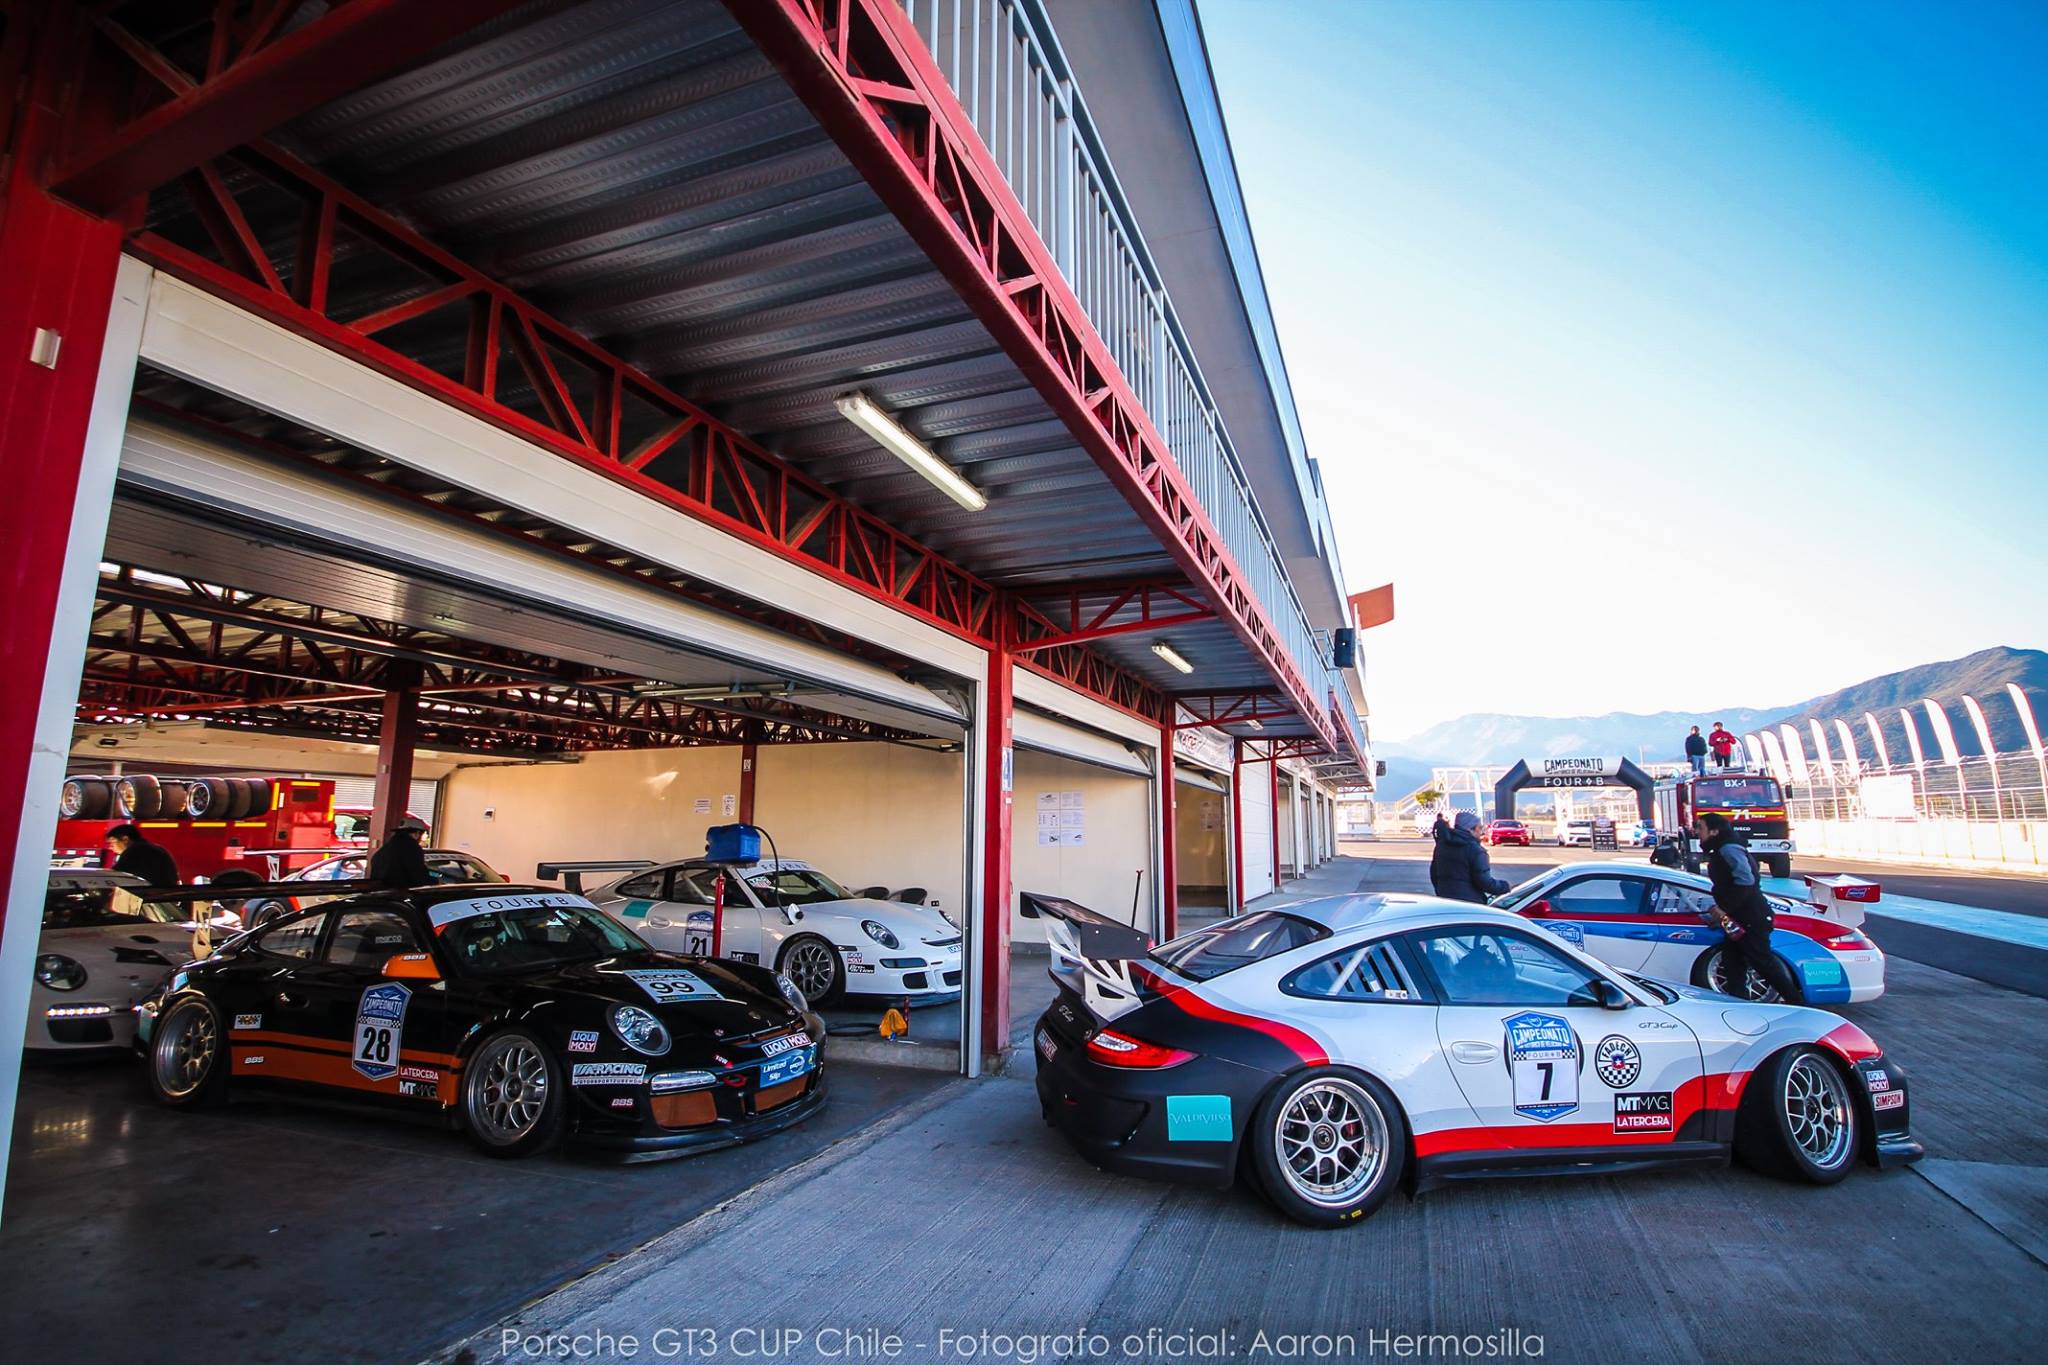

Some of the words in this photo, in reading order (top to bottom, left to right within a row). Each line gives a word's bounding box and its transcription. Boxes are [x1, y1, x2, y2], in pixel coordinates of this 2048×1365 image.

[1544, 758, 1603, 772] CAMPEONATO
[1544, 776, 1582, 786] FOUR
[1724, 779, 1747, 788] BX-1
[471, 897, 538, 912] FOUR
[691, 936, 708, 956] 21
[649, 981, 695, 994] 99
[363, 998, 402, 1016] CAMPEONATO
[361, 1026, 392, 1063] 28
[572, 1033, 597, 1041] LIQUI
[764, 1039, 789, 1055] LIQUI
[787, 1033, 809, 1047] MOLY
[1513, 1028, 1570, 1046] CAMPEONATO
[570, 1041, 596, 1050] MOLY
[1602, 1041, 1631, 1058] FADECH
[1536, 1062, 1553, 1101] 7
[1869, 1081, 1888, 1090] MOLY
